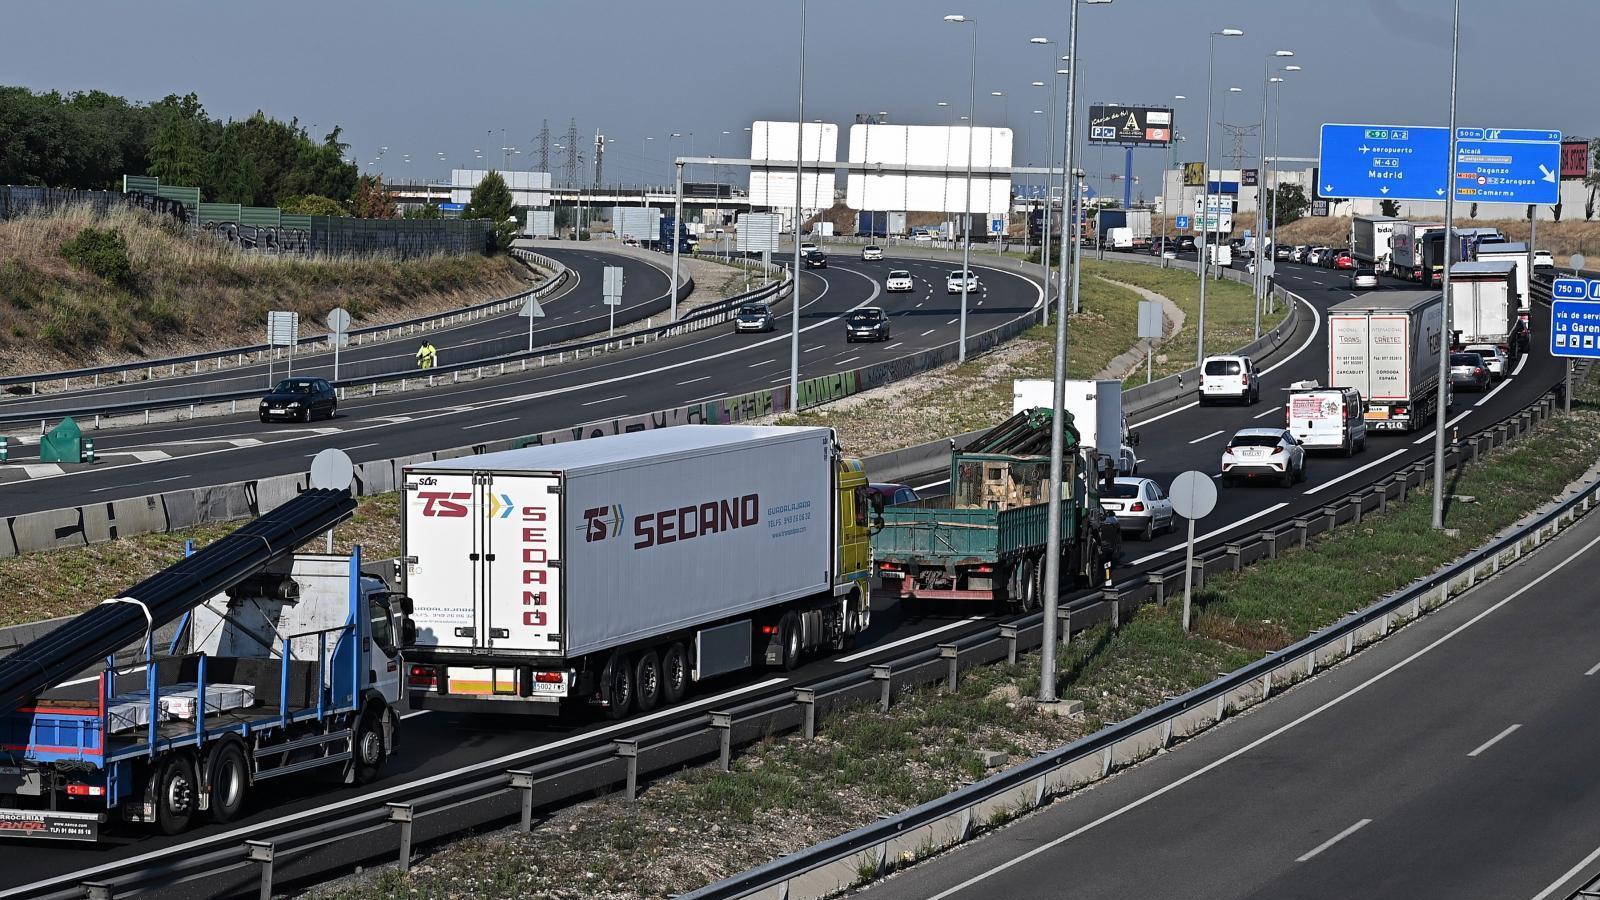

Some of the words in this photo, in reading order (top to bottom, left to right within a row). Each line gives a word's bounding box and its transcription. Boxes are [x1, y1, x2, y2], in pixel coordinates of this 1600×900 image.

[1368, 170, 1403, 179] Madrid
[1477, 167, 1509, 175] Daganzo
[1558, 285, 1572, 293] 750
[1557, 311, 1568, 319] vía
[1556, 322, 1567, 332] La
[417, 491, 472, 518] TS
[767, 500, 811, 516] GUADALAJARA
[583, 505, 609, 543] TS
[634, 493, 759, 550] SEDANO
[522, 506, 547, 626] SEDANO
